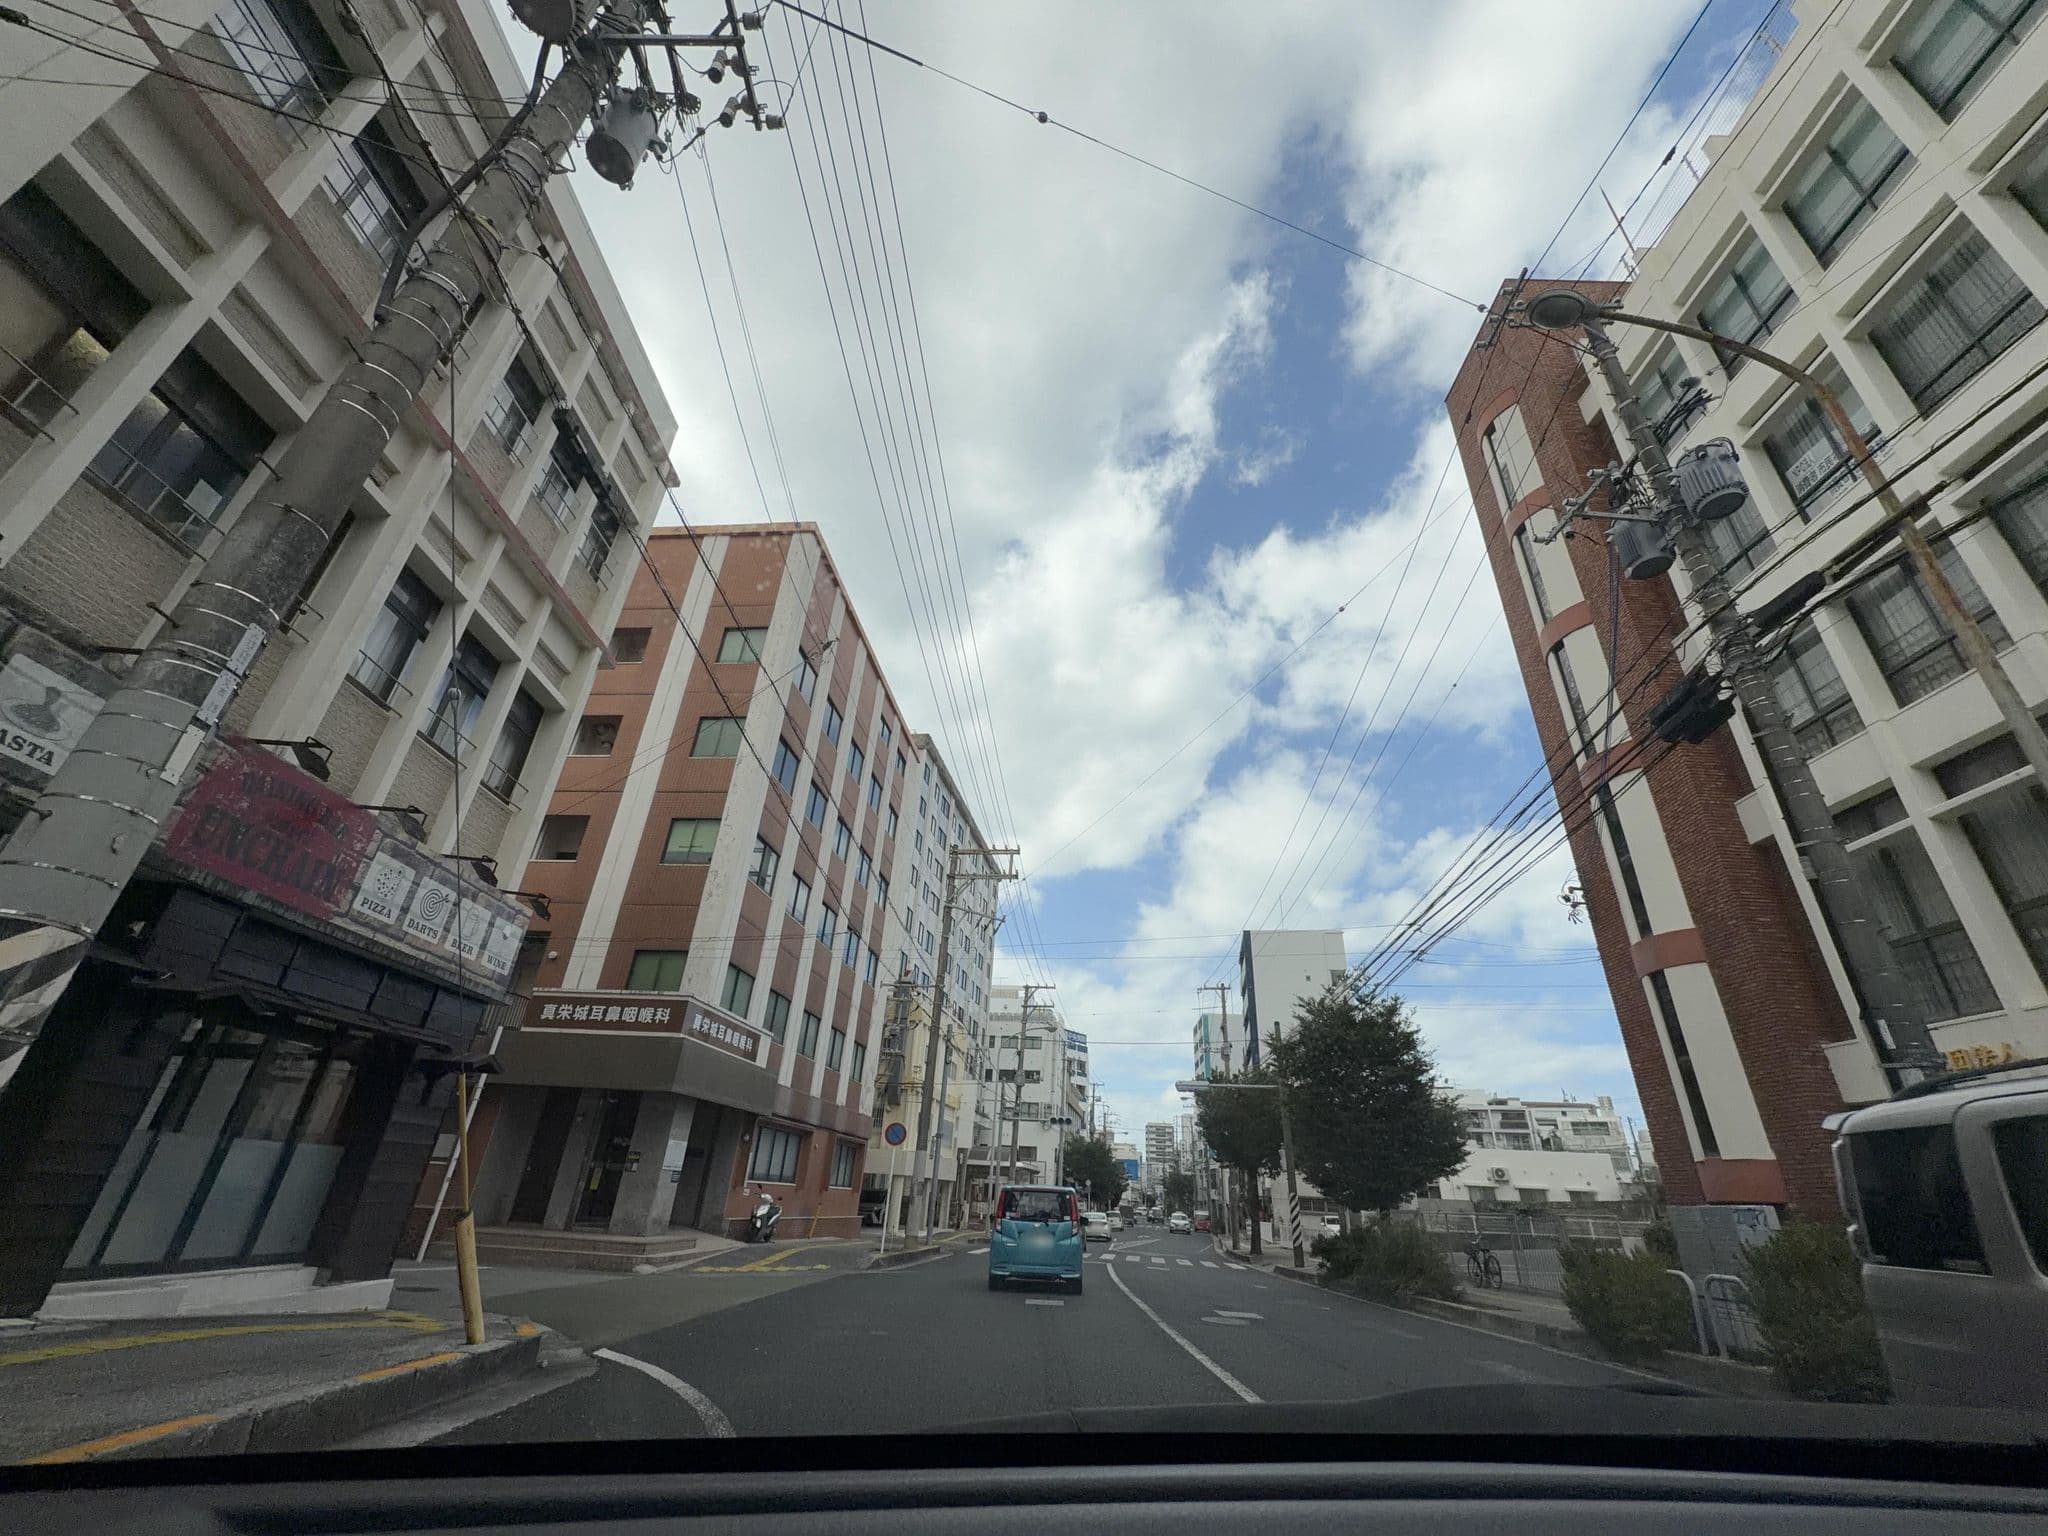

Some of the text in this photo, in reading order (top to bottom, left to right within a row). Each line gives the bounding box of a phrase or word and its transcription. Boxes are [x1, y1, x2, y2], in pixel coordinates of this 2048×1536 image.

[360, 897, 392, 919] PIZZA
[406, 918, 439, 940] DARTS
[451, 938, 474, 956] BEER
[487, 955, 507, 971] WINE
[540, 1003, 671, 1024] 真栄城耳鼻咽喉科
